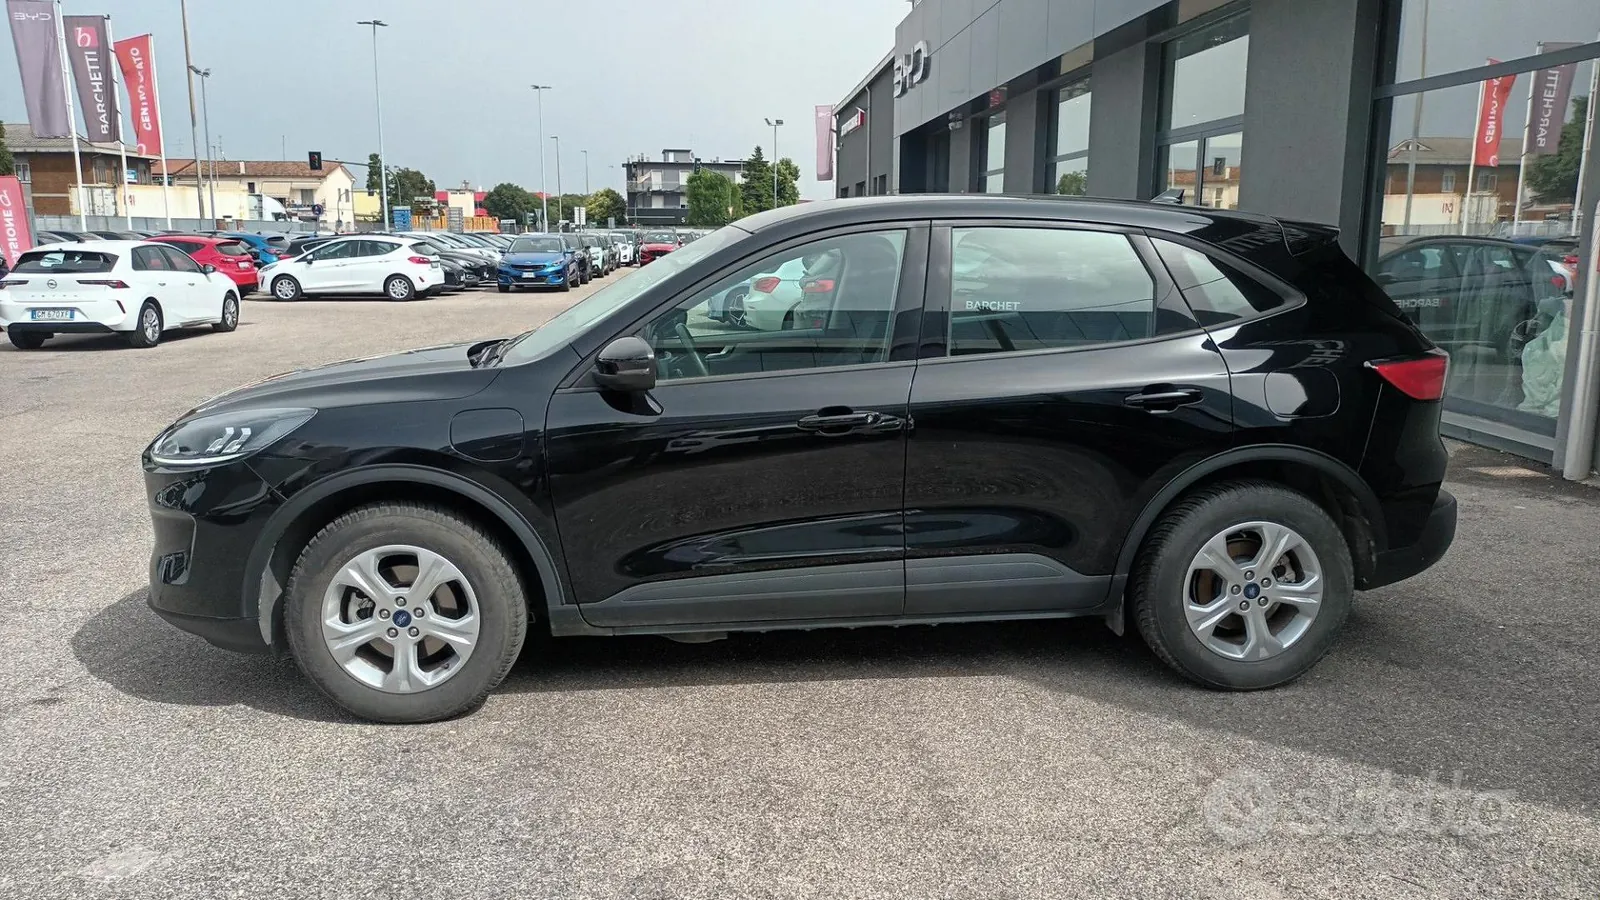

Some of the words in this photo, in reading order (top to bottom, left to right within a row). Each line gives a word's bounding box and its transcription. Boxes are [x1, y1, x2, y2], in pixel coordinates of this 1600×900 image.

[14, 12, 52, 21] BYD
[84, 51, 109, 135] BARCHETTI
[894, 40, 931, 98] BYD
